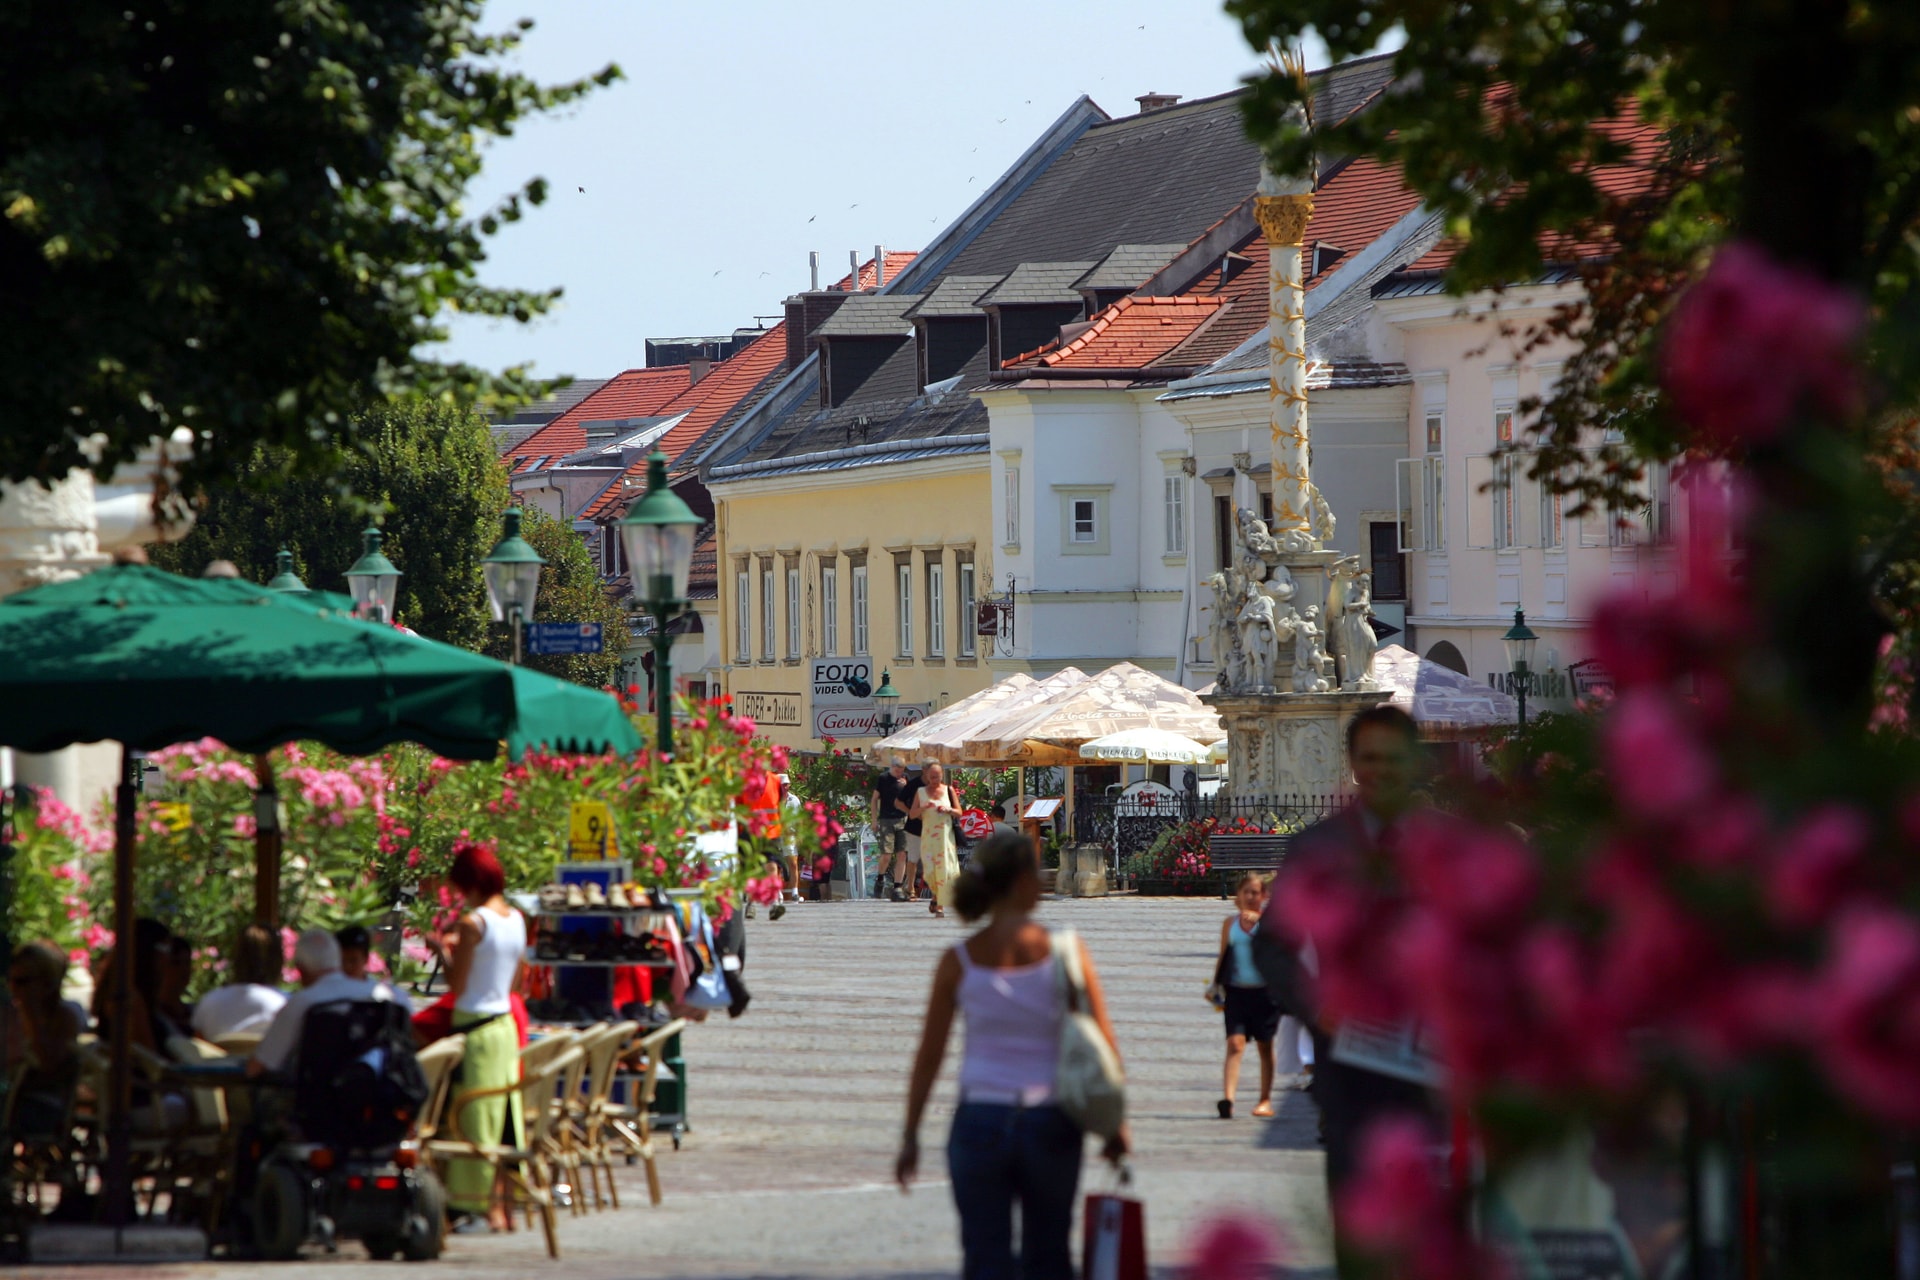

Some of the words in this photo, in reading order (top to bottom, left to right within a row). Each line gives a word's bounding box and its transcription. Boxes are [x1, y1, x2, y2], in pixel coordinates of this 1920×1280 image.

[815, 664, 868, 681] FOTO
[815, 686, 844, 695] VIDEO
[743, 695, 765, 720] LEDER
[823, 713, 879, 734] Gewuß
